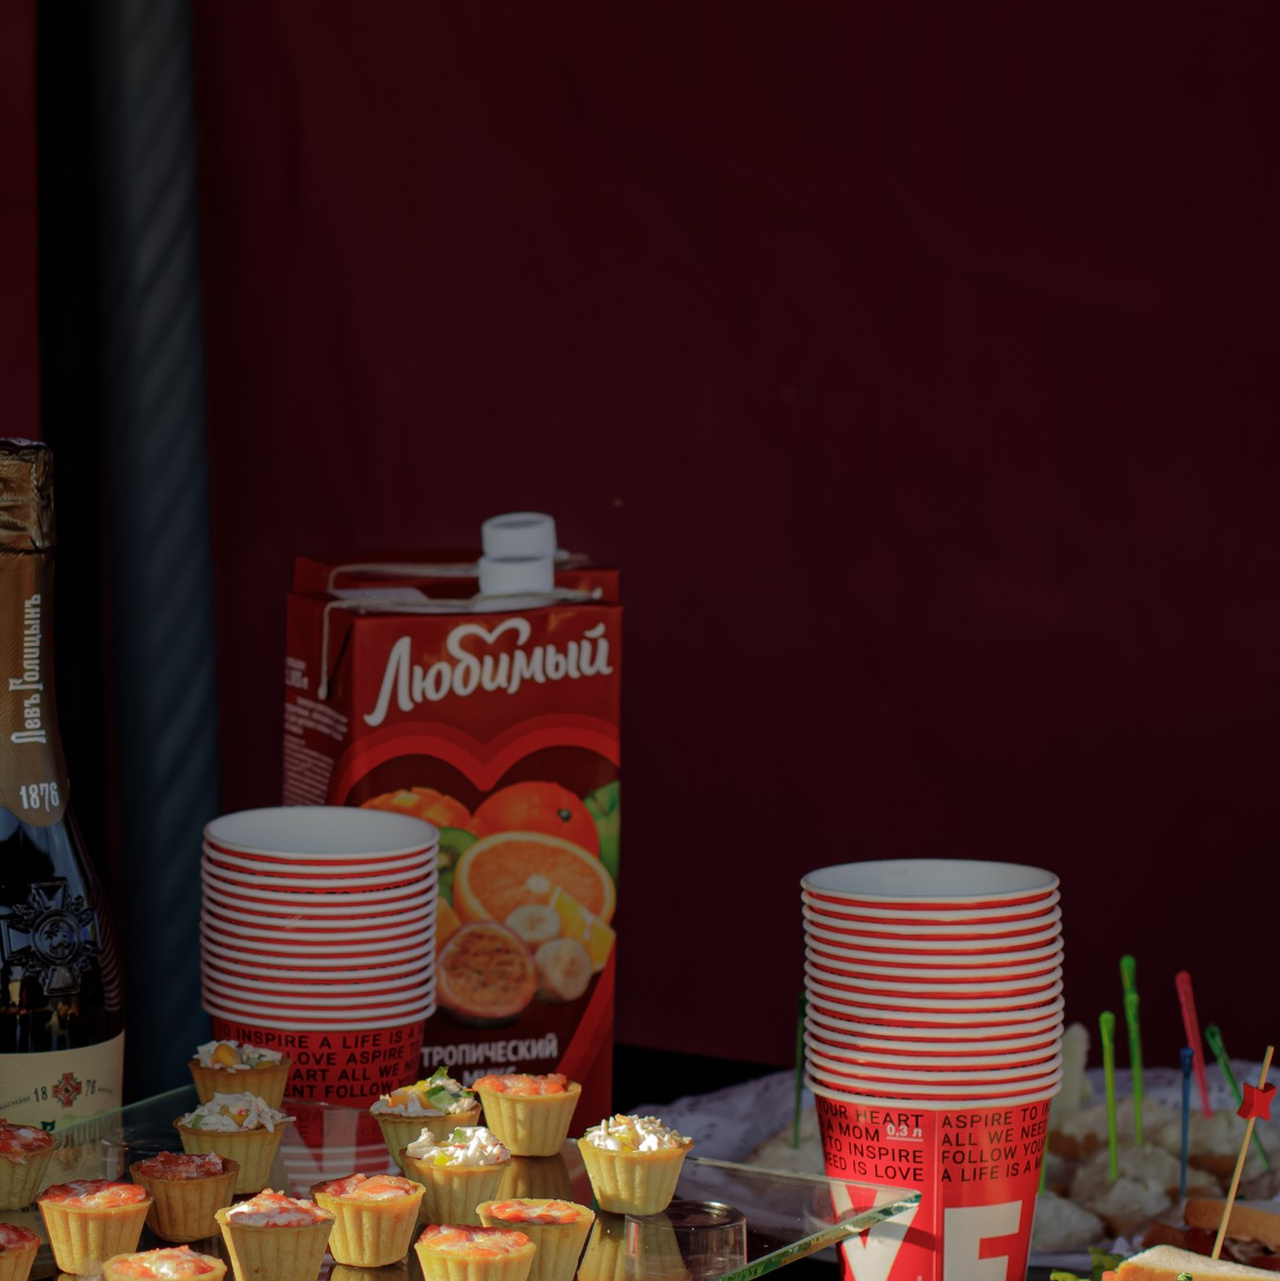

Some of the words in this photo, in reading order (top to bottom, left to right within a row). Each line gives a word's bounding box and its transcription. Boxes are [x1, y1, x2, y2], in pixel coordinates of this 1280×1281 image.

[9, 594, 44, 692] Голицынъ
[363, 617, 613, 727] Любимый
[11, 692, 47, 744] Левъ
[19, 782, 60, 812] 1876
[236, 1027, 309, 1049] INSPIRE
[319, 1036, 331, 1049] A
[342, 1034, 380, 1049] LIFE
[389, 1030, 402, 1044] IS
[346, 1045, 405, 1065] ASPIRE
[421, 1032, 558, 1068] ТРОПИЧЕСКИЙ
[338, 1067, 371, 1081] ALL
[379, 1062, 400, 1078] WE
[324, 1081, 392, 1098] FOLLOW
[856, 1108, 924, 1128] HEART
[942, 1111, 1013, 1129] ASPIRE
[1021, 1107, 1037, 1122] TO
[839, 1124, 880, 1142] MOM
[941, 1133, 978, 1147] ALL
[988, 1128, 1014, 1144] WE
[827, 1135, 843, 1150] TO
[849, 1141, 924, 1164] INSPIRE
[942, 1145, 1017, 1164] FOLLOW
[853, 1160, 868, 1175] IS
[874, 1164, 924, 1182] LOVE
[941, 1169, 953, 1182] A
[961, 1165, 999, 1182] LIFE
[1007, 1162, 1019, 1177] IS
